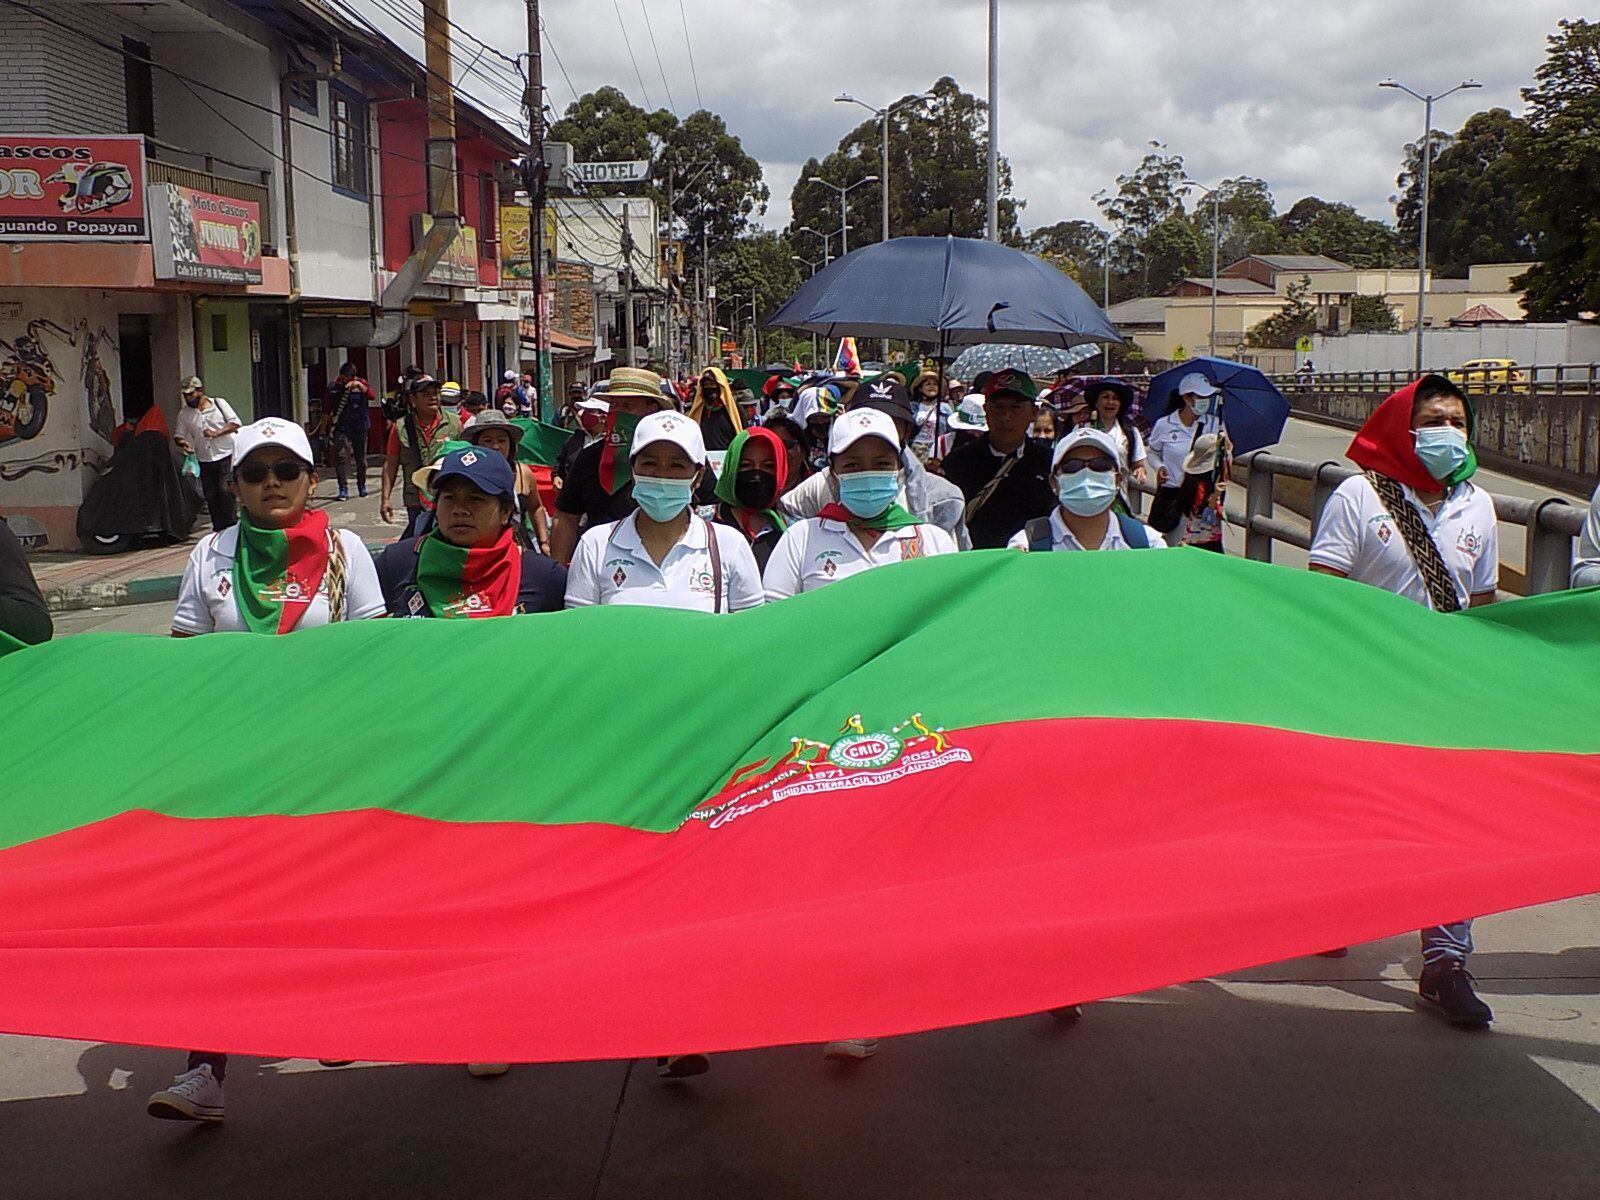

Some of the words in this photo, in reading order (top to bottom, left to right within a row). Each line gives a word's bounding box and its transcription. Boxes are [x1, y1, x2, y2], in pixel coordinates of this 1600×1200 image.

[583, 164, 639, 180] HOTEL
[192, 193, 217, 213] Moto
[219, 199, 249, 219] Cascos
[67, 221, 138, 234] Popayan
[200, 220, 240, 252] JUNIOR
[849, 742, 882, 758] CRIC
[776, 783, 815, 799] UNIDAD
[816, 780, 851, 792] TIERRA
[852, 771, 899, 788] CULTURA
